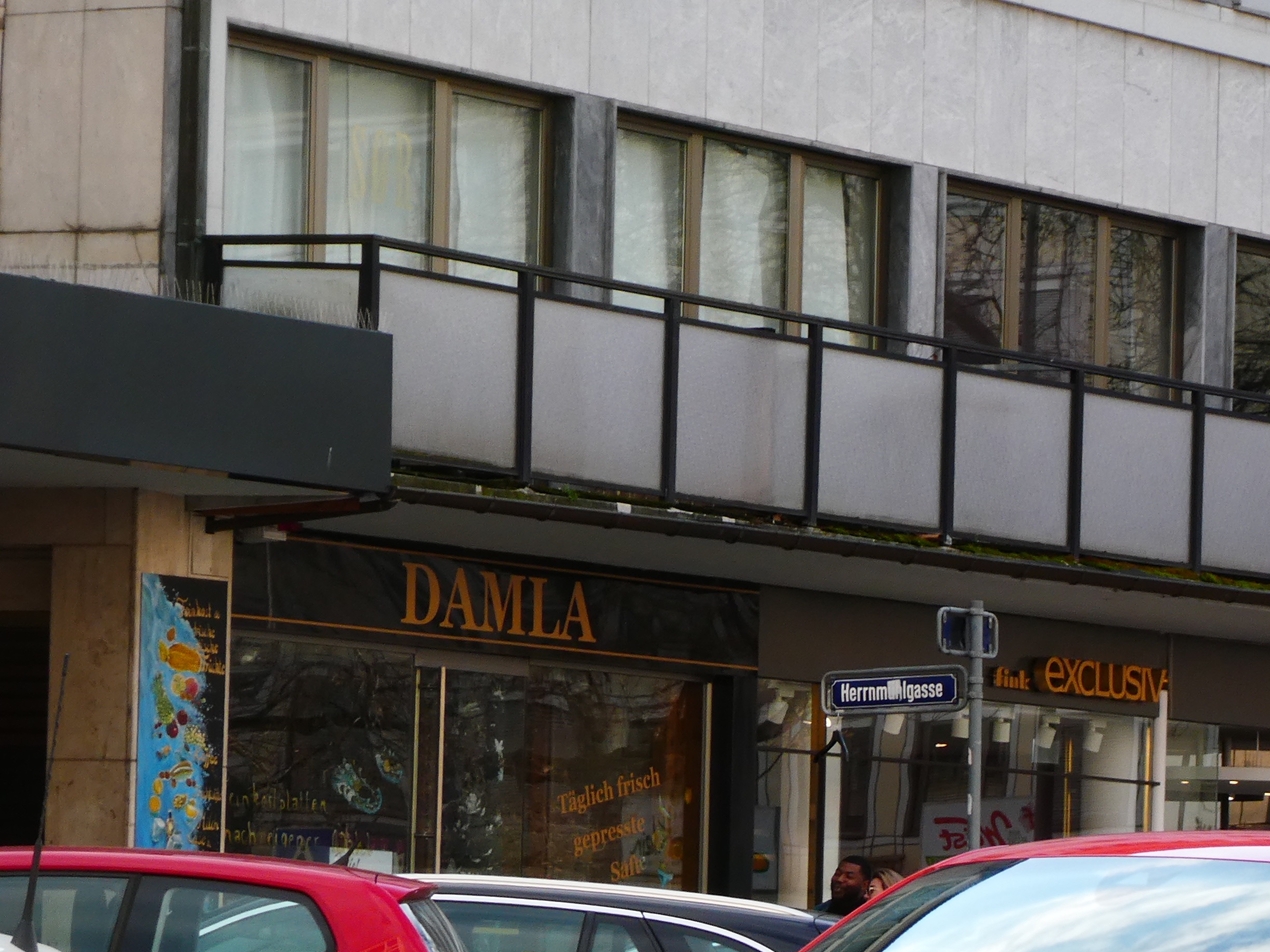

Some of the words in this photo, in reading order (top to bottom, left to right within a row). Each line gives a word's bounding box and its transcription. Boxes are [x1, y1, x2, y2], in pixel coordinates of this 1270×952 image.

[401, 562, 597, 643] DAMLA
[994, 666, 1031, 691] fink
[557, 780, 614, 814] Täglich
[617, 766, 661, 797] frisch
[573, 817, 646, 857] gepresste
